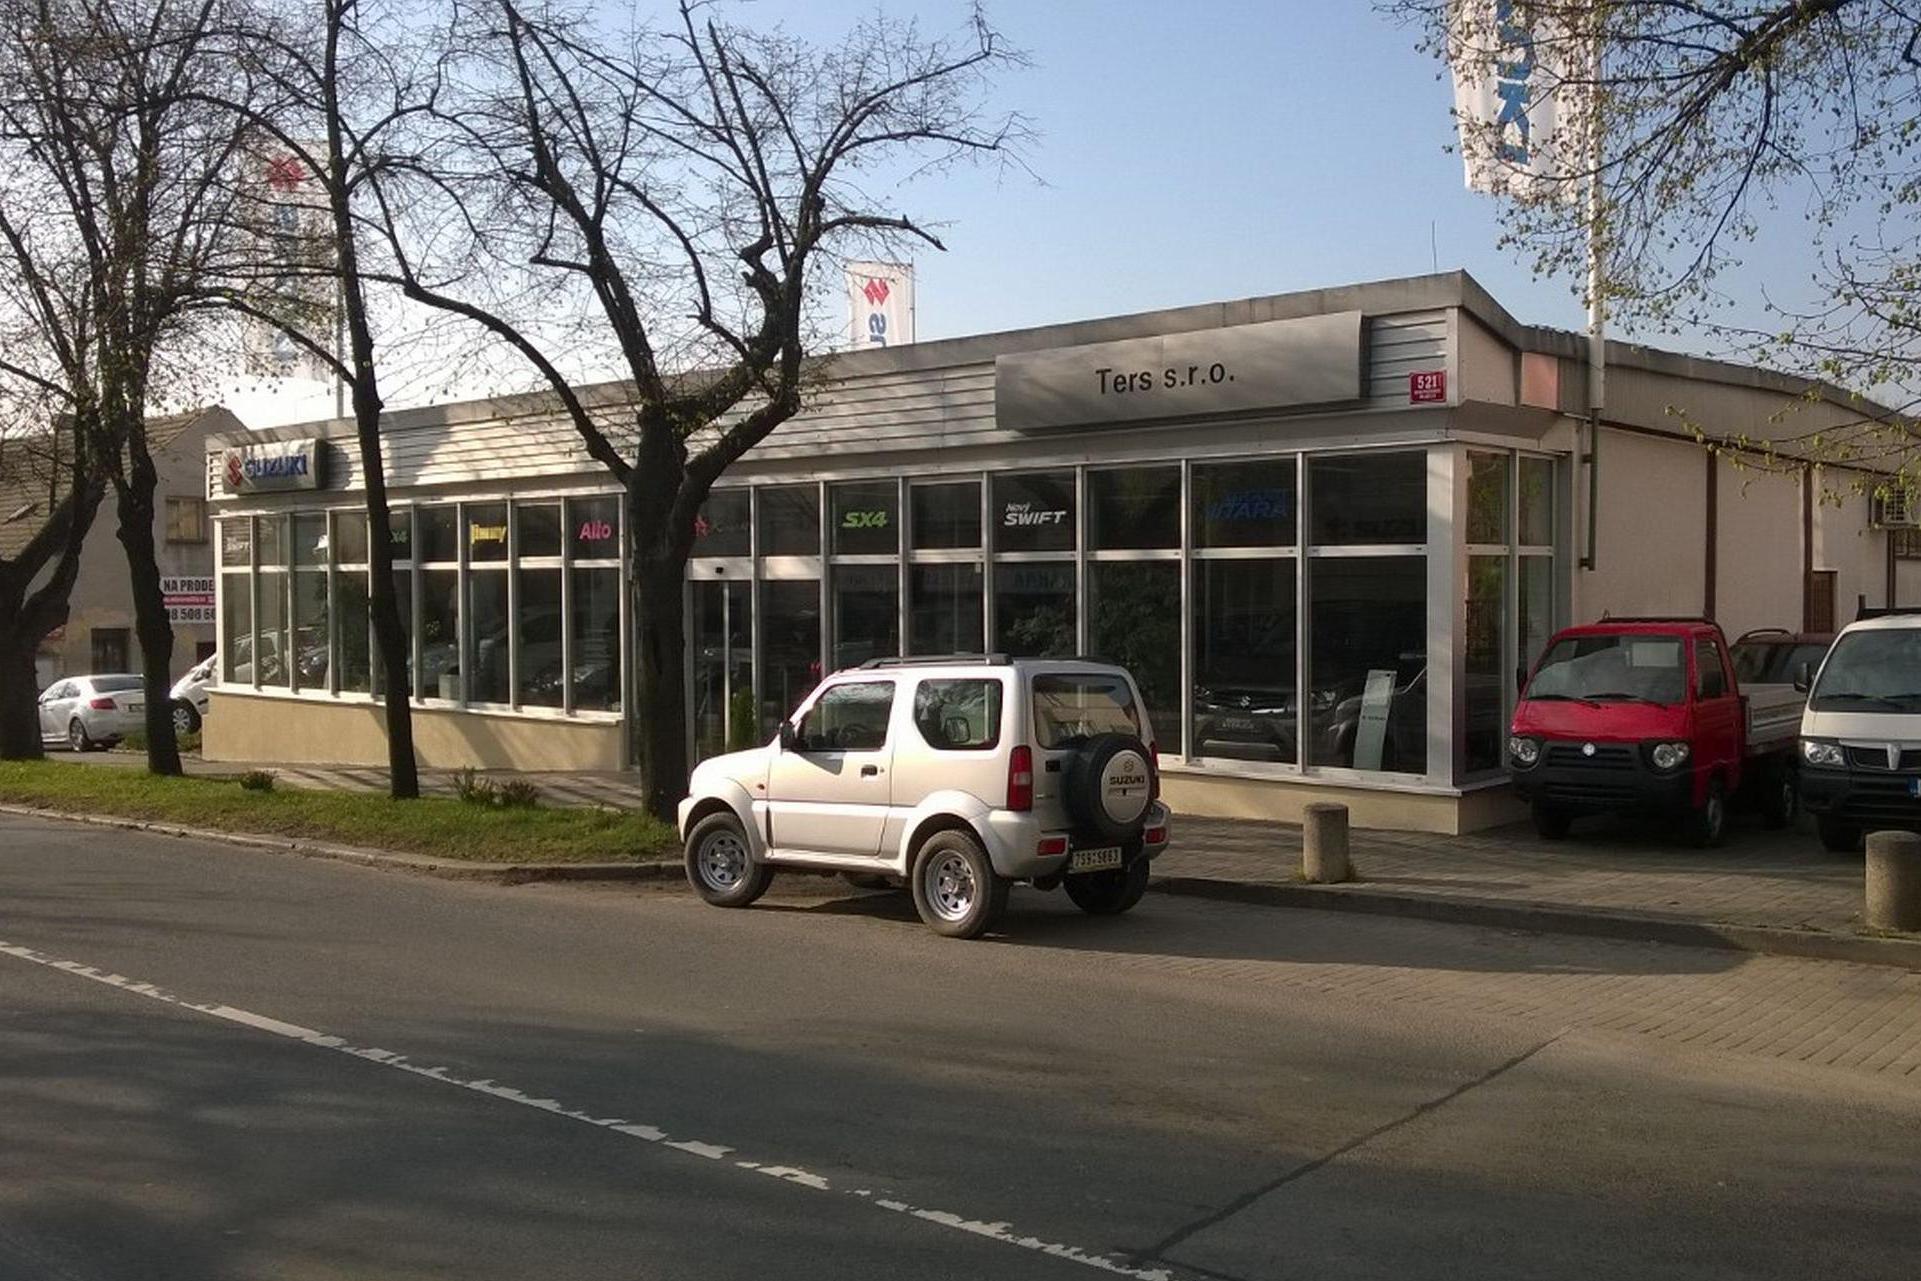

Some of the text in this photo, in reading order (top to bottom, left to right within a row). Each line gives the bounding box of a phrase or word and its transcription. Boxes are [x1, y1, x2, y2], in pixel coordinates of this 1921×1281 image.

[1095, 363, 1234, 394] Ters s.r.o.
[1417, 375, 1437, 389] 521
[842, 511, 888, 529] SX4
[1004, 511, 1067, 526] SWIFT
[164, 579, 178, 592] NA
[1109, 774, 1145, 786] SUZUKI
